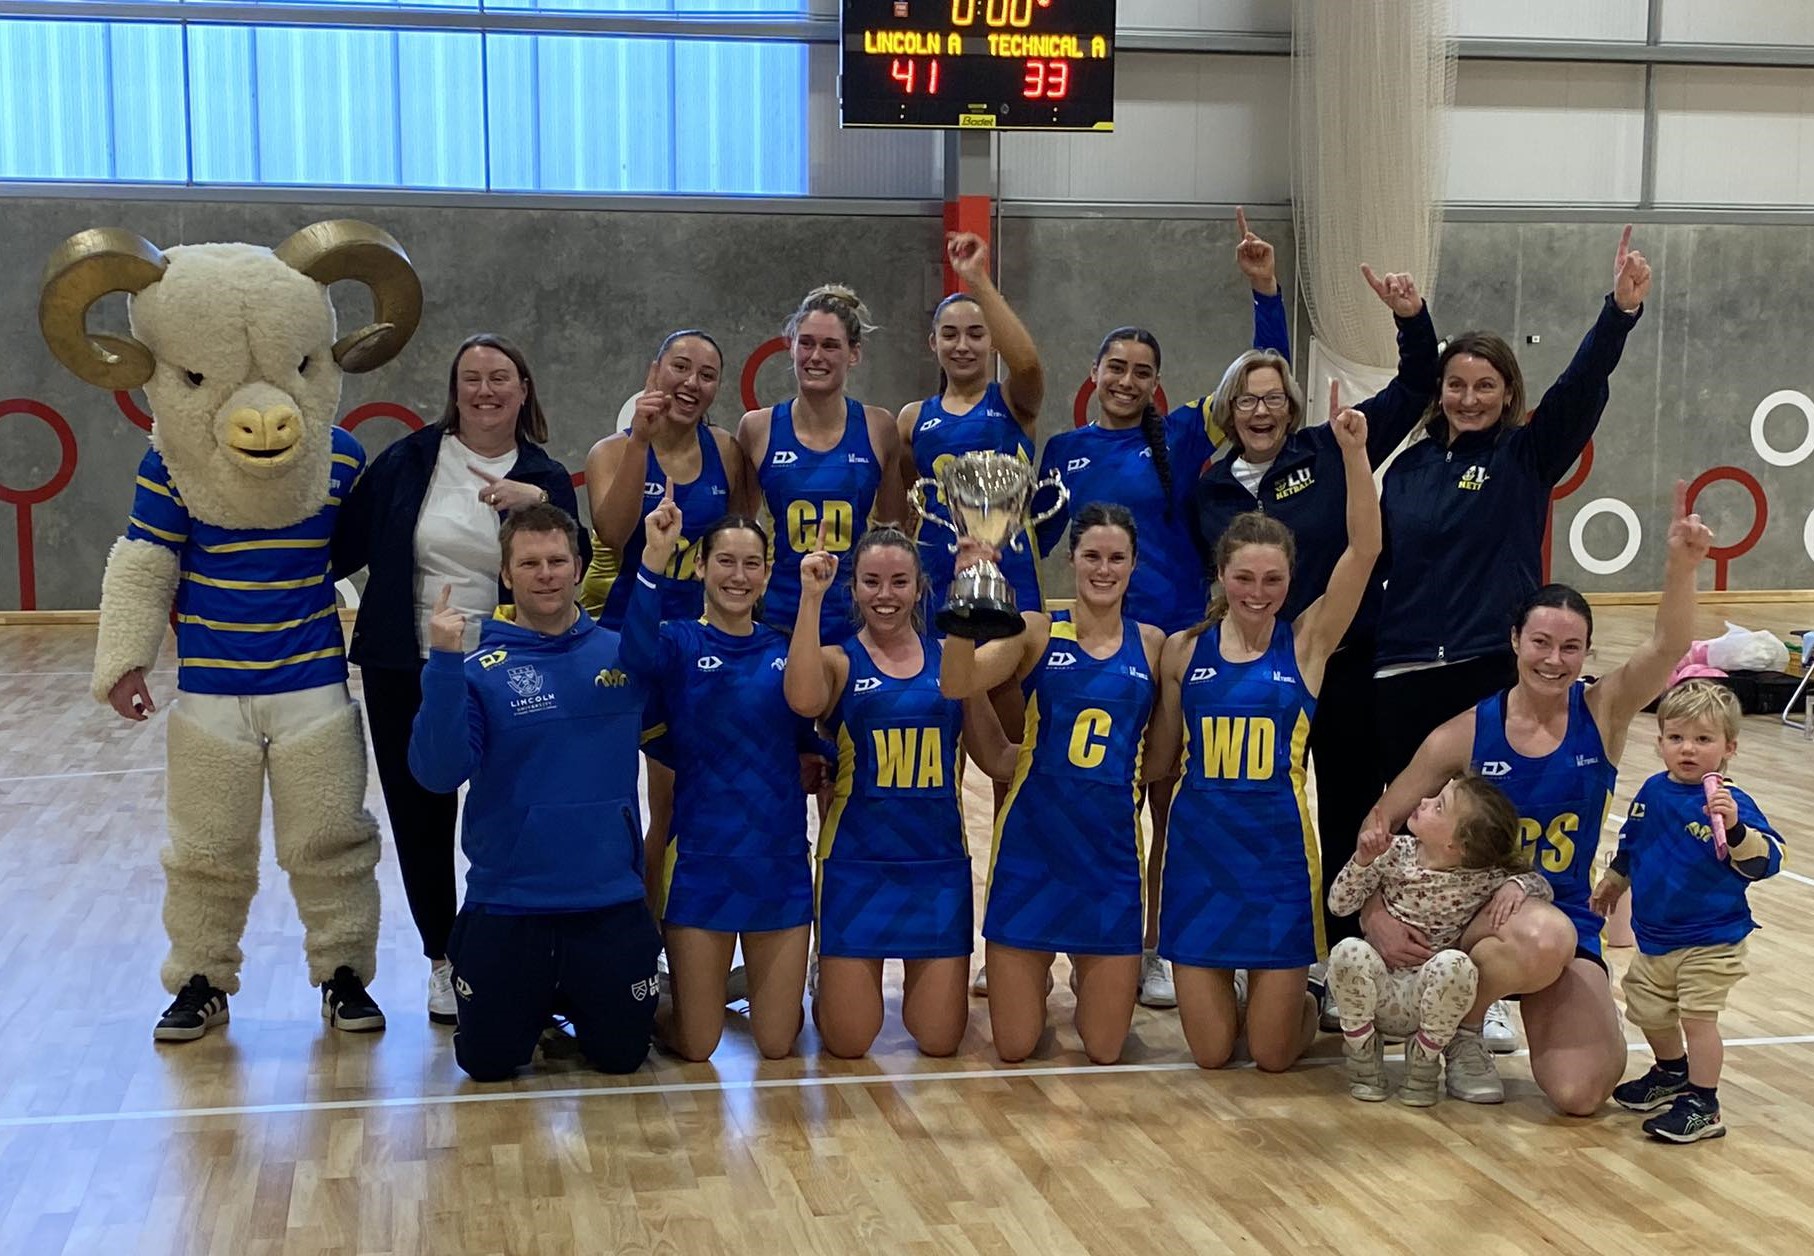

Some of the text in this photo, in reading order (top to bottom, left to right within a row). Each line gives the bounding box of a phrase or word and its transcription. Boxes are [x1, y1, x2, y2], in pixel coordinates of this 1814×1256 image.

[865, 30, 962, 55] LINCOLN A
[987, 34, 1106, 58] TECHNICAL A
[891, 59, 940, 95] 41
[1023, 60, 1069, 98] 33
[1275, 479, 1315, 500] NETBALL
[1288, 467, 1312, 487] LU
[787, 500, 853, 553] GD
[510, 693, 555, 708] LINCOLN
[1068, 708, 1112, 768] C
[1201, 716, 1276, 780] WD
[872, 727, 944, 788] WA
